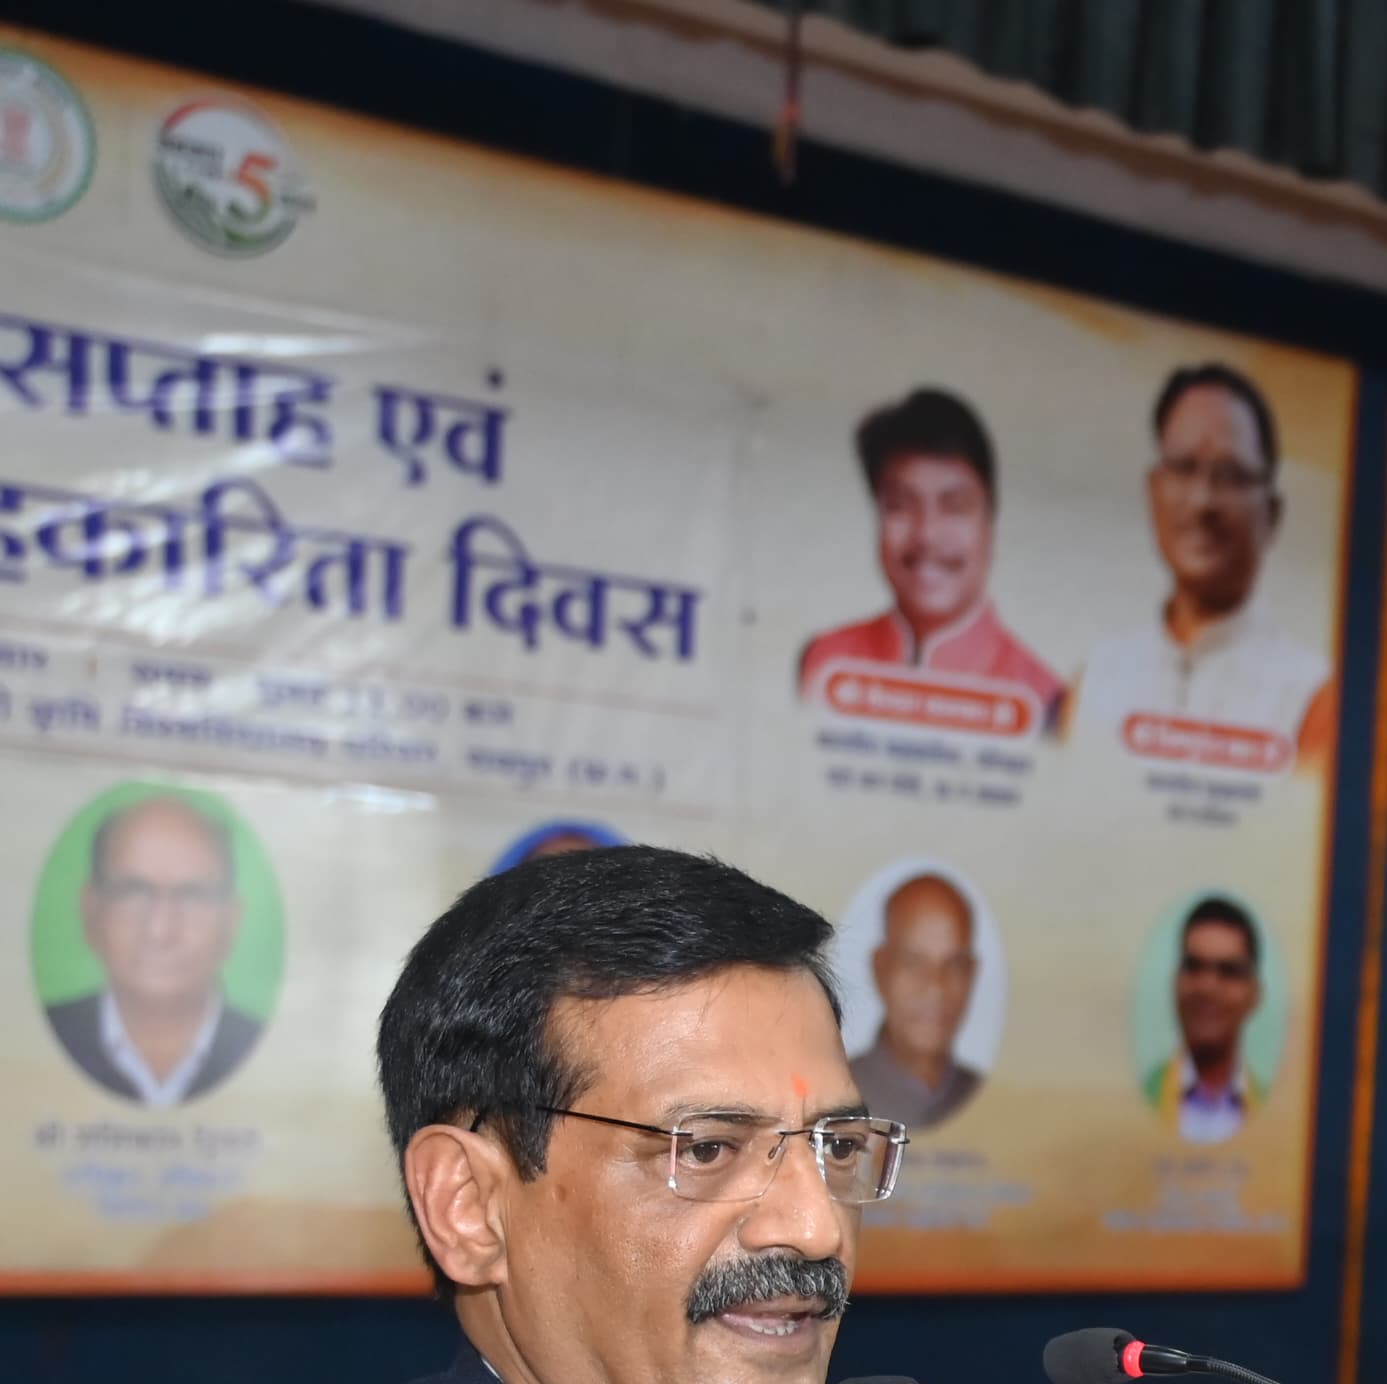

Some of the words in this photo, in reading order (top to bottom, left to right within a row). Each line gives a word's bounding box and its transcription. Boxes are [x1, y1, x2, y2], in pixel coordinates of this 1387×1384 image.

[0, 314, 337, 470] सप्ताह
[372, 368, 512, 486] एवं
[450, 516, 703, 661] दिवस
